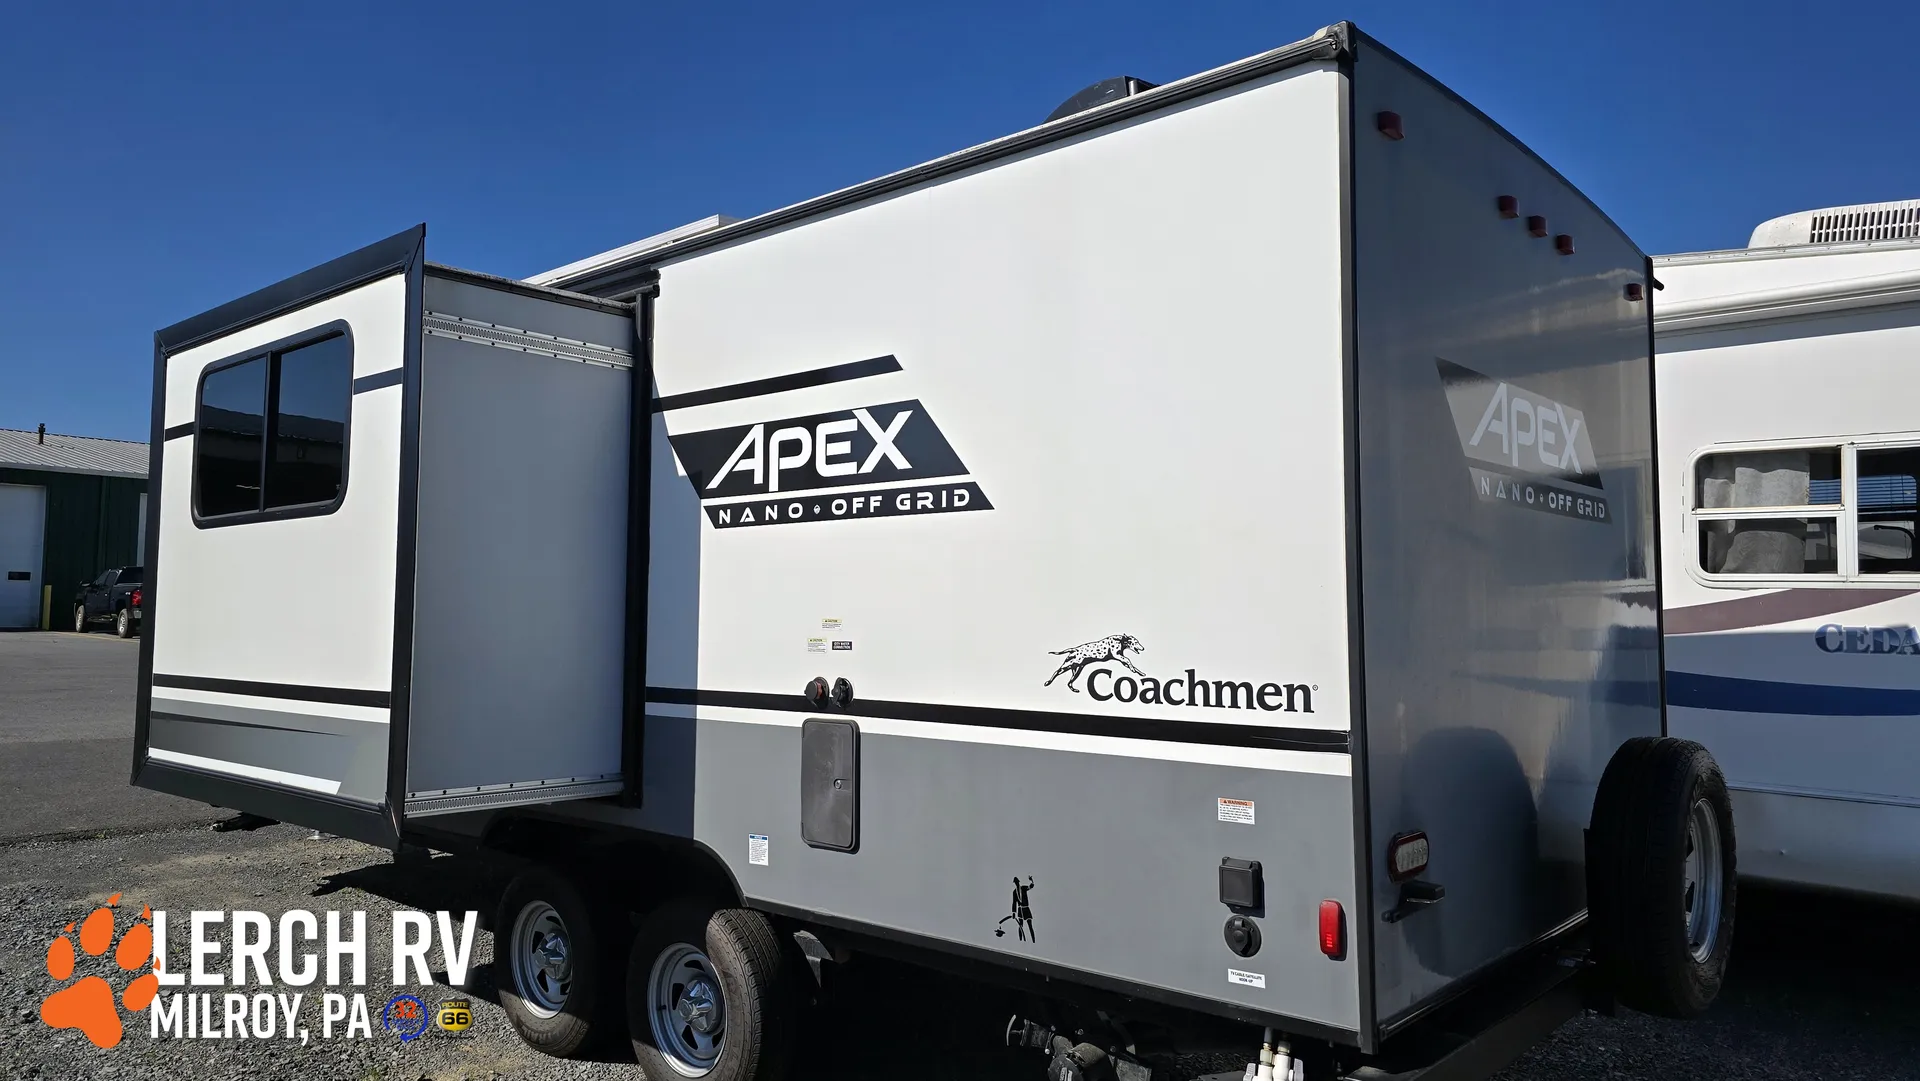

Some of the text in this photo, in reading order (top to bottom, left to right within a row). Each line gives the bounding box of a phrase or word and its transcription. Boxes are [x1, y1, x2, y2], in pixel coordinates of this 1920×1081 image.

[705, 408, 914, 492] APEX
[1469, 381, 1583, 475] APEX
[718, 488, 971, 525] NANO OFF GRID
[1481, 477, 1605, 519] NANO OFF GRID
